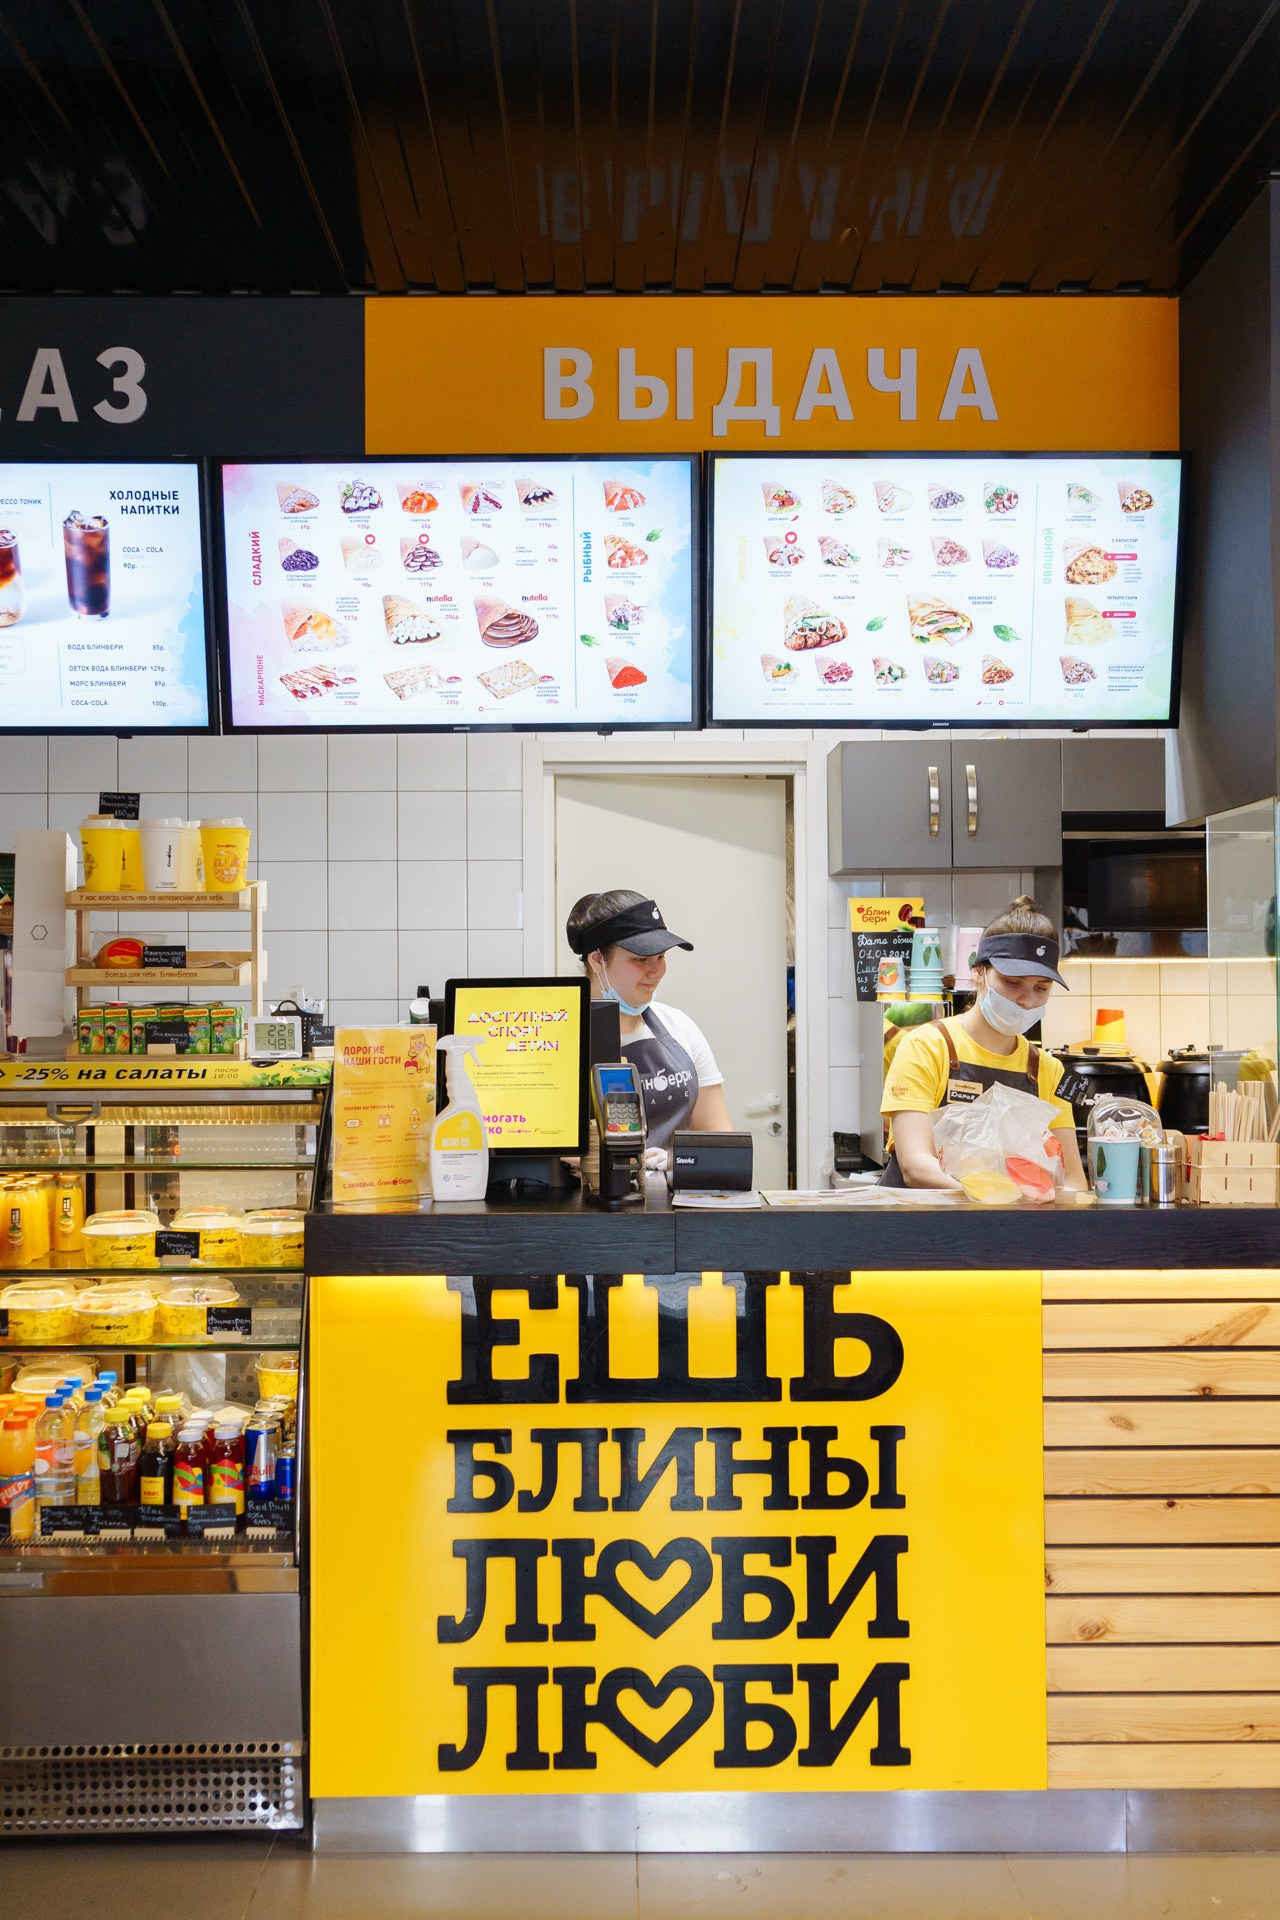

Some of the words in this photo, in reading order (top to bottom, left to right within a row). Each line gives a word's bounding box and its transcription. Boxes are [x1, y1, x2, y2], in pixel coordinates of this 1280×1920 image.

[0, 346, 148, 424] АЗ
[543, 347, 999, 436] ВЫДАЧА
[109, 490, 179, 501] ХОЛОДНЫЕ
[120, 504, 180, 515] НАПИТКИ
[249, 531, 262, 586] СЛАДКИЙ
[580, 531, 592, 583] РЫБНЫЙ
[1042, 527, 1054, 585] ОВОЩНОЙ
[123, 562, 138, 570] 90р.
[426, 594, 453, 603] nutella
[521, 593, 548, 602] nutella
[91, 665, 109, 673] ВОДА
[257, 654, 265, 706] МАСКАРПОНЕ
[866, 906, 890, 916] блин
[862, 914, 887, 925] бери
[857, 934, 889, 947] Дата
[160, 971, 200, 979] БлинБерри.
[467, 1008, 569, 1023] ДОСТУПНЫЙ
[488, 1026, 542, 1038] СПОРТ
[268, 1038, 286, 1050] 48
[506, 1040, 560, 1052] ДЕТЯМ
[343, 1046, 385, 1056] ДОРОГИЕ
[343, 1057, 371, 1066] НАШИ
[373, 1056, 401, 1065] ГОСТИ
[15, 1067, 70, 1080] -25%
[77, 1068, 114, 1080] на
[118, 1067, 208, 1080] салаты
[485, 1126, 503, 1135] ко
[446, 1270, 904, 1405] ЕШЬ
[446, 1425, 907, 1513] БЛИНЫ
[248, 1500, 267, 1511] Red
[268, 1500, 290, 1511] Bull
[437, 1535, 911, 1644] ЛЮБИ
[437, 1662, 912, 1772] ЛЮБИ
